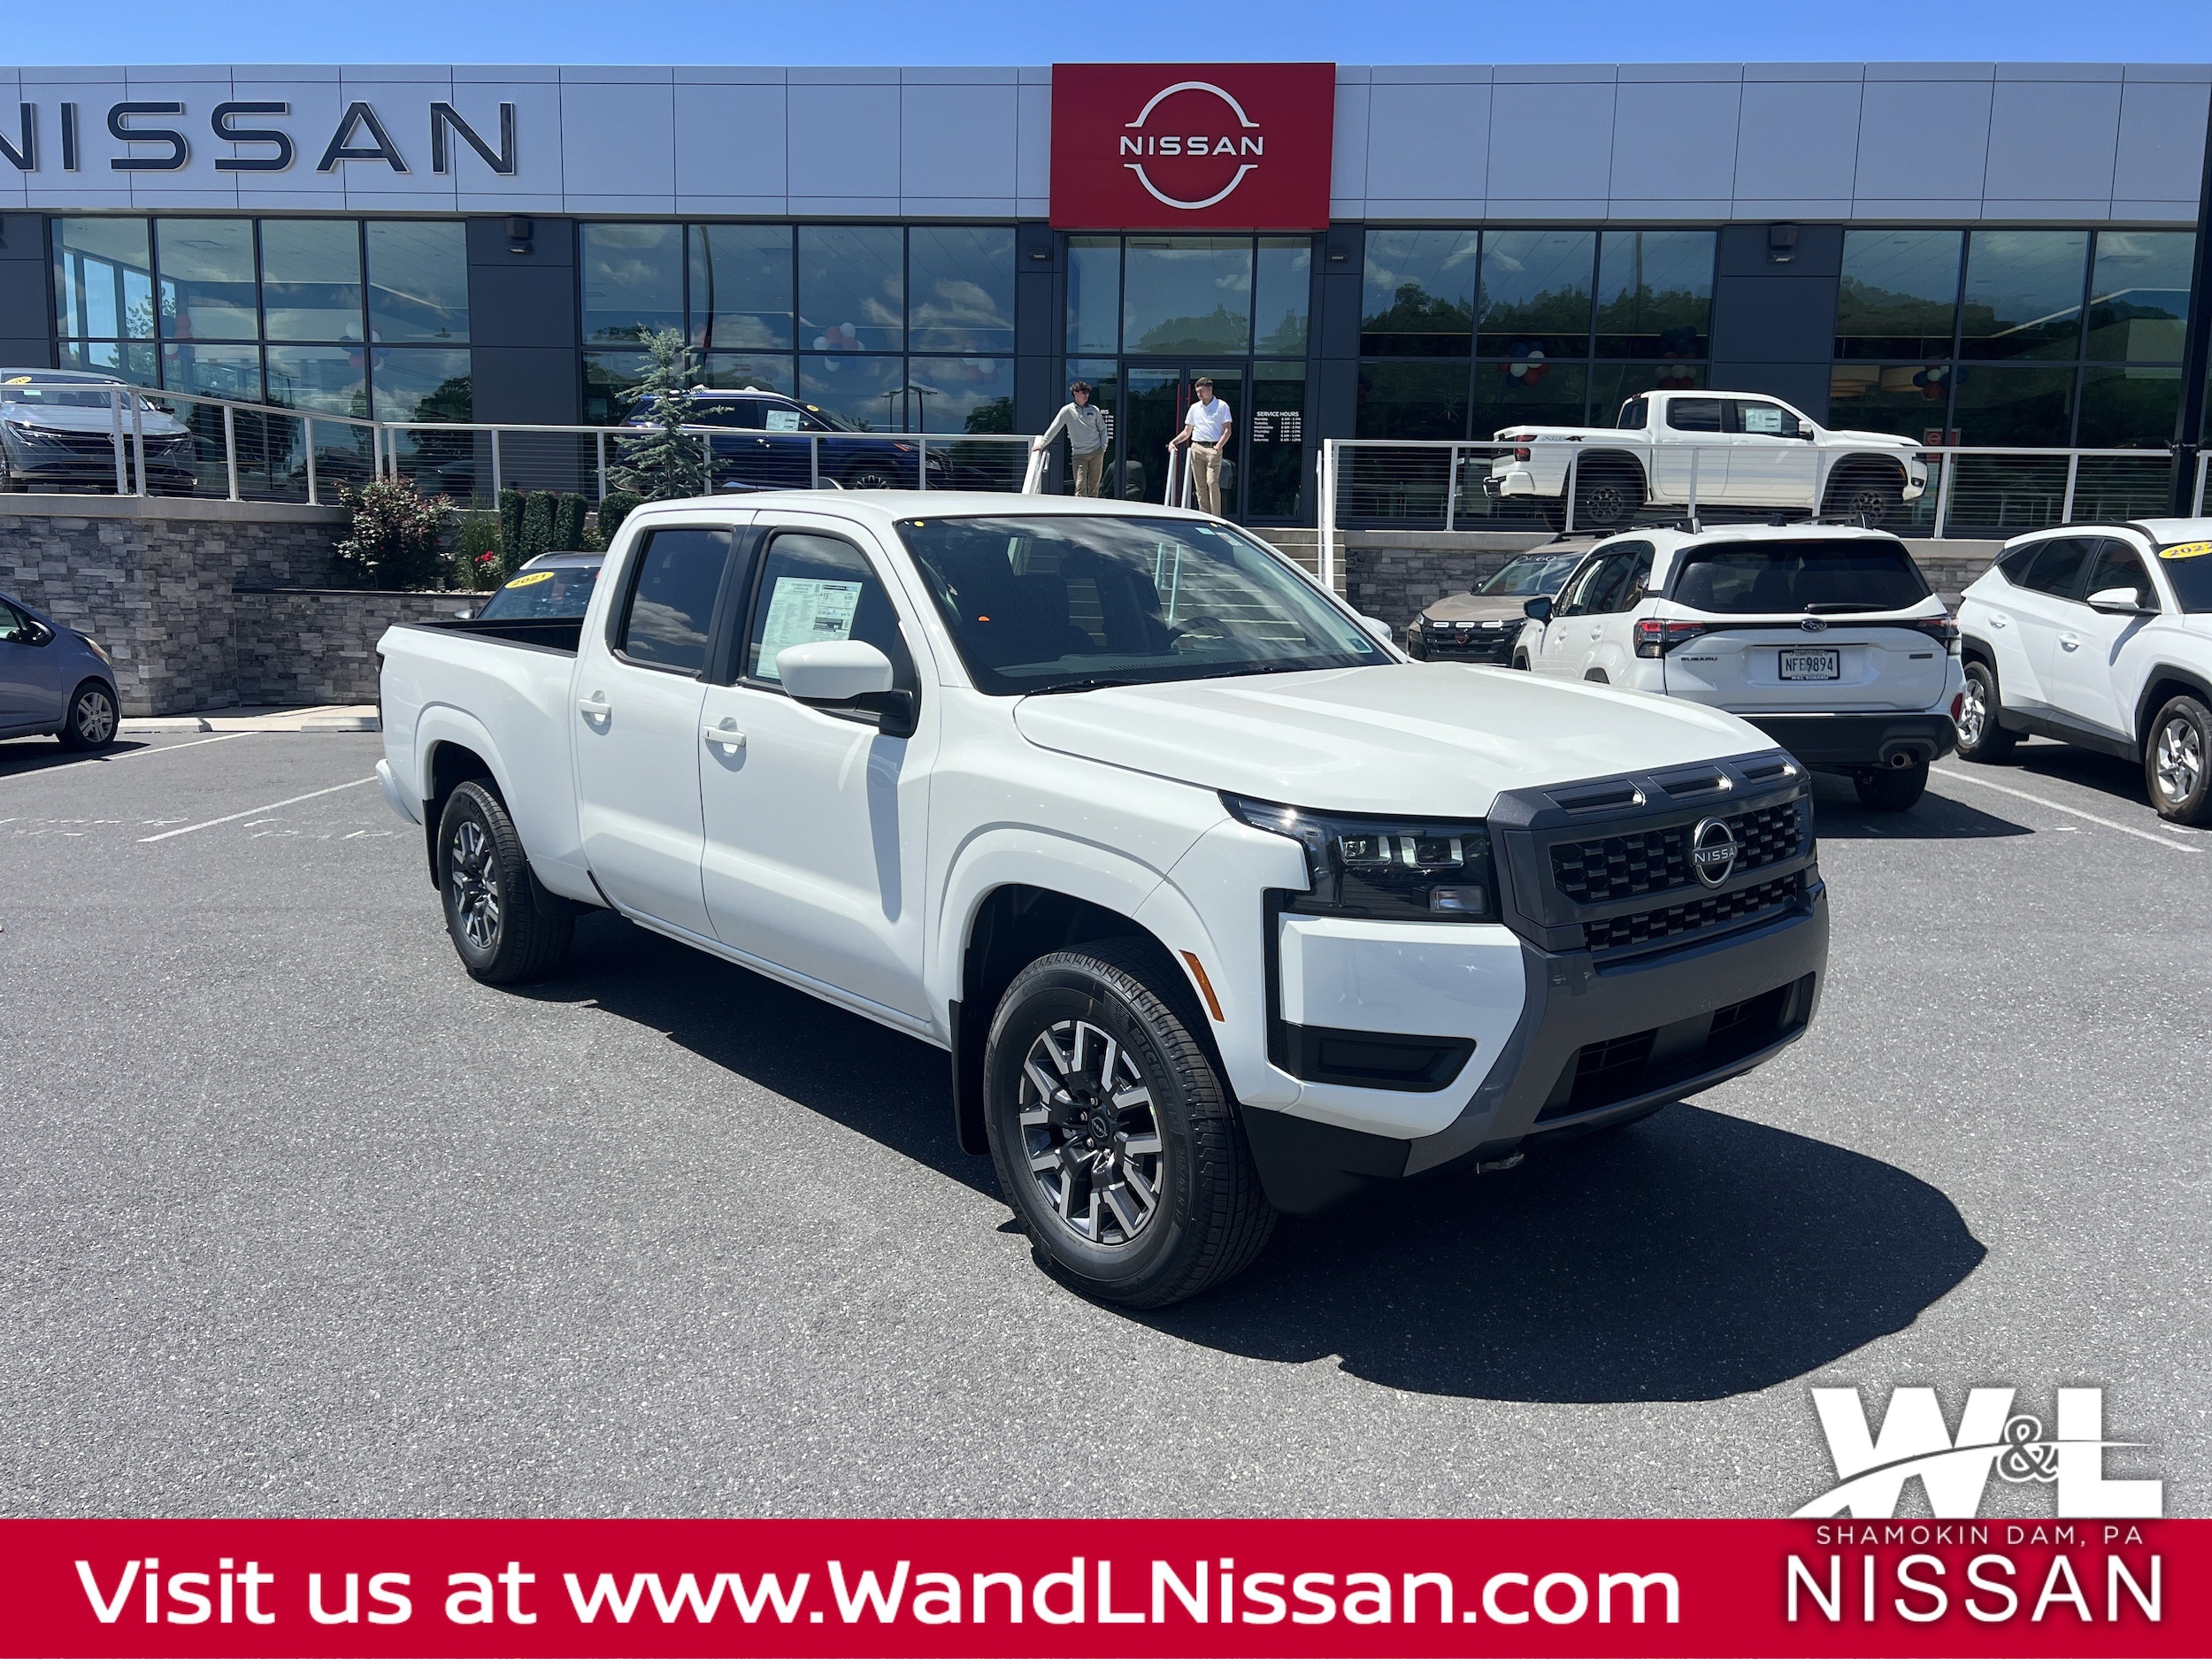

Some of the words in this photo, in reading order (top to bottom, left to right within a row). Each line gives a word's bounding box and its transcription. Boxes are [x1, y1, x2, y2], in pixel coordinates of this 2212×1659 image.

[1119, 135, 1263, 156] NISSAN
[511, 572, 547, 587] 2021
[1694, 847, 1737, 863] NISSA
[1130, 1026, 1181, 1125] MICHELIN
